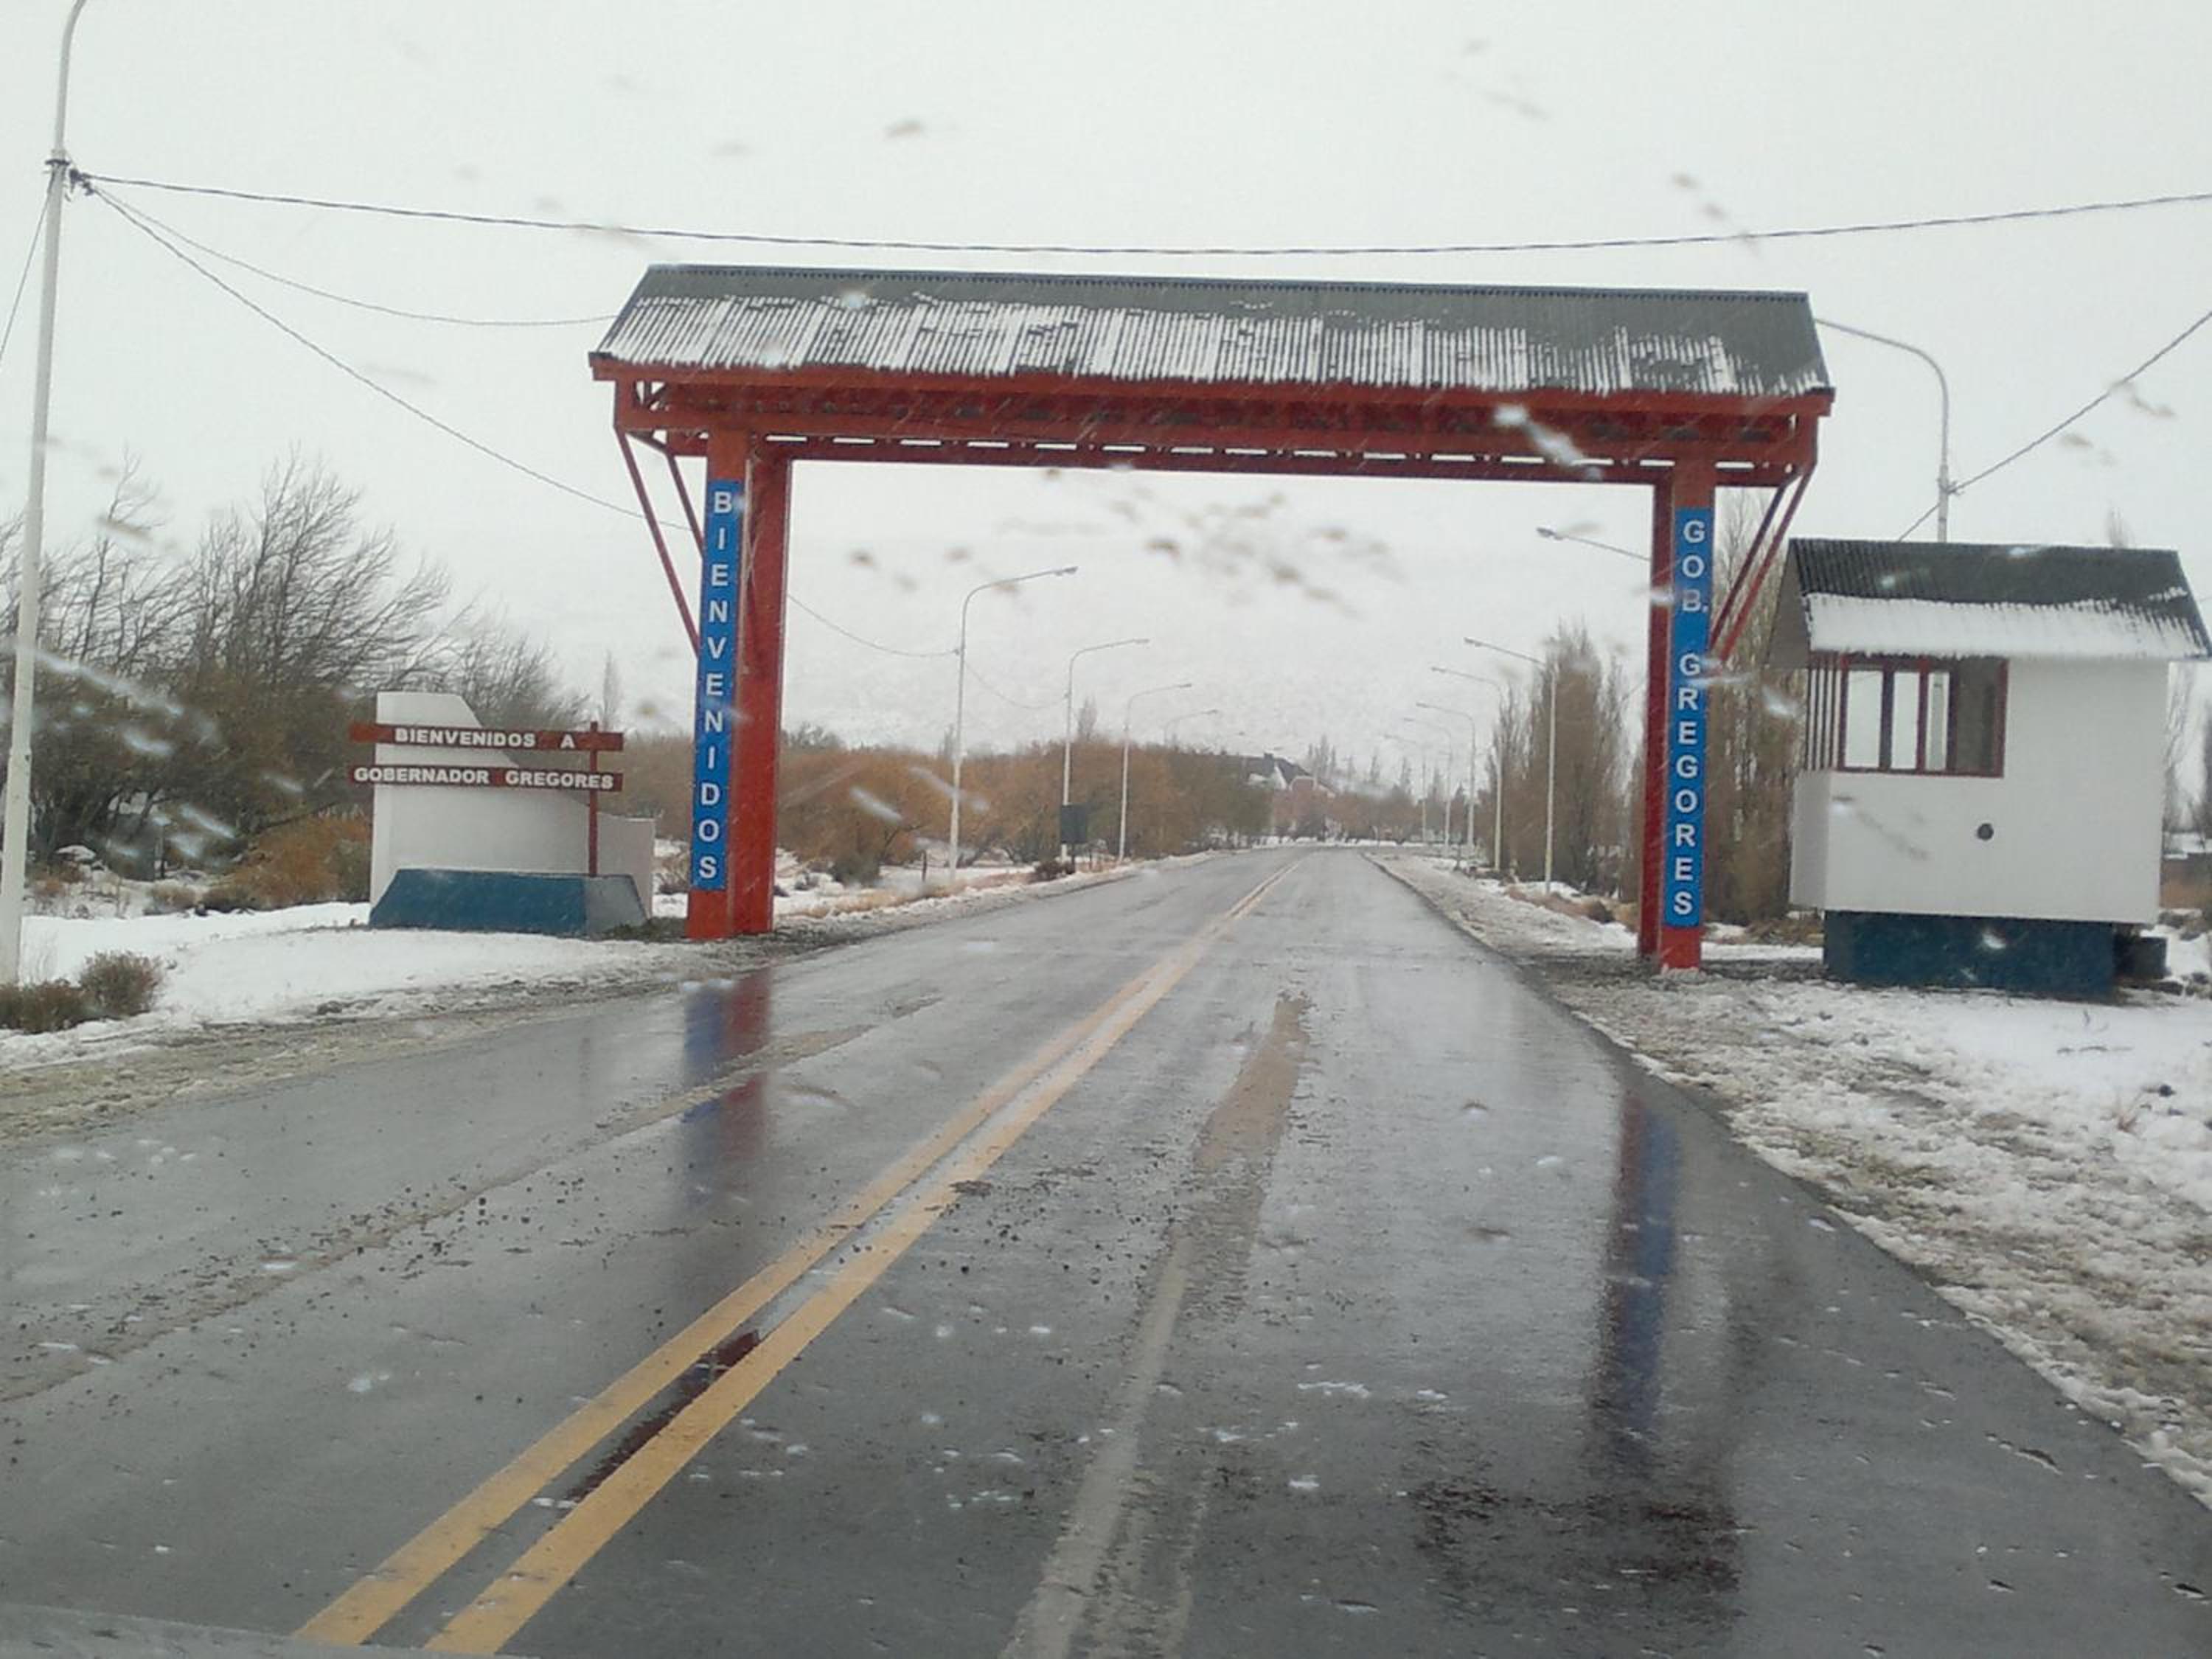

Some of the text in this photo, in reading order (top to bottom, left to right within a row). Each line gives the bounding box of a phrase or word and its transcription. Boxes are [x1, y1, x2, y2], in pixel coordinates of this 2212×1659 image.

[354, 766, 614, 790] GOBERNADOR GREGORES
[394, 728, 575, 749] BIENVENIDOS A
[698, 491, 733, 880] BIENVENIDOS
[1673, 520, 1708, 916] GOB. GREGORES
